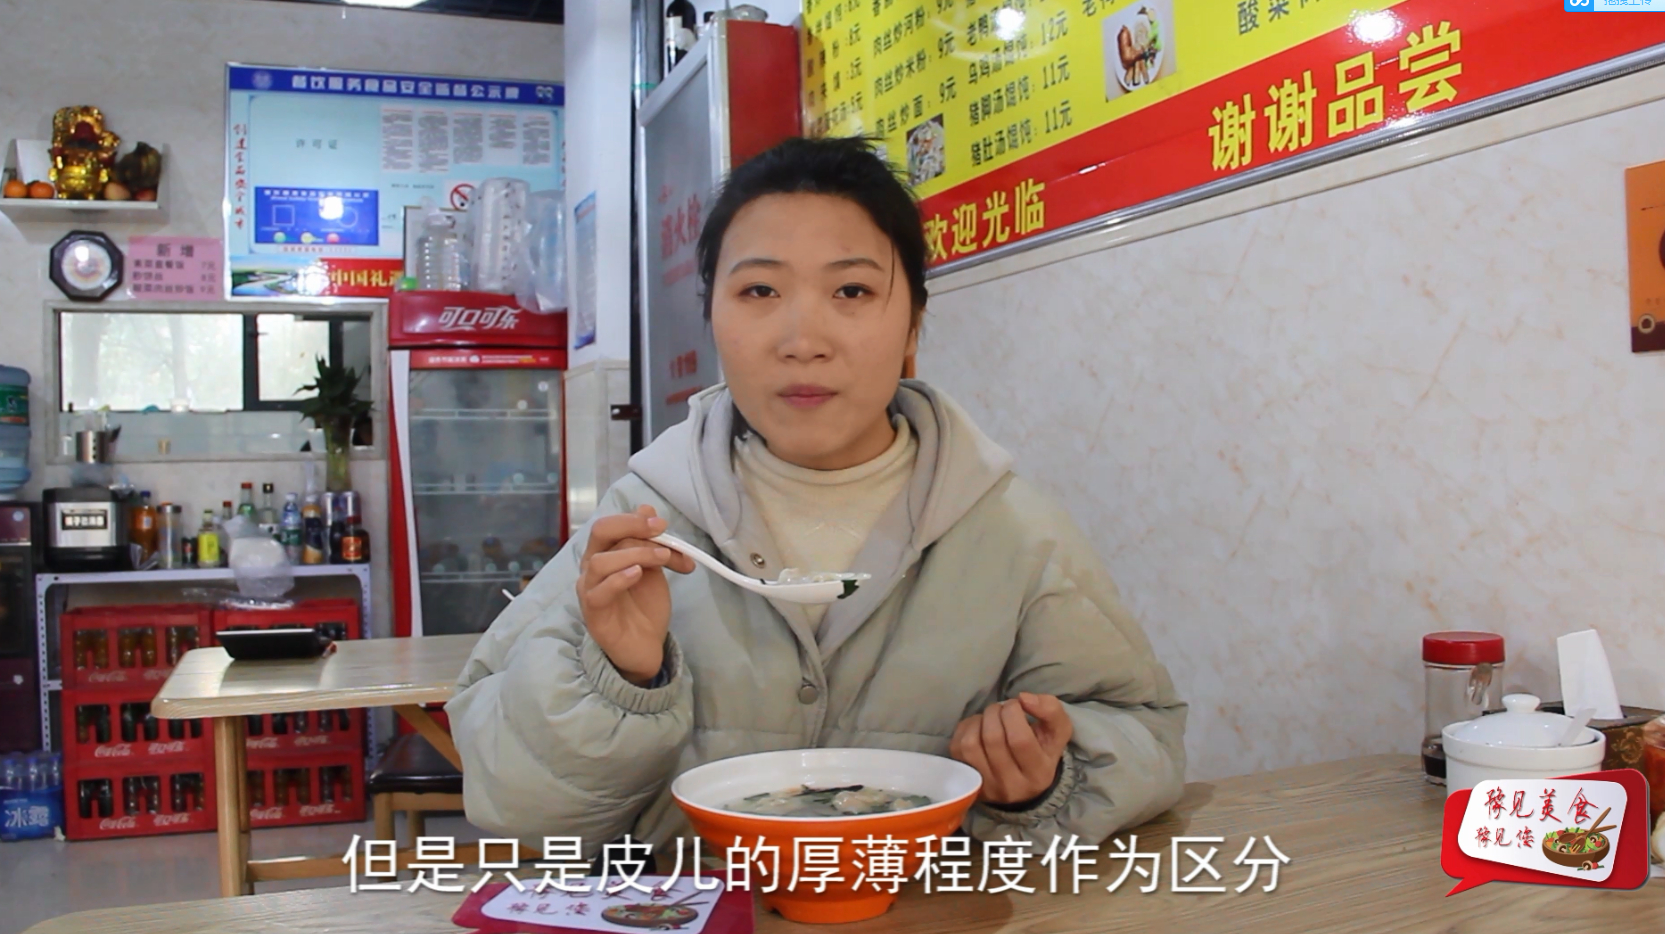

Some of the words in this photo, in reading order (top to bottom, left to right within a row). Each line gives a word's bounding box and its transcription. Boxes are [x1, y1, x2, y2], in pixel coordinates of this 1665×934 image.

[1041, 10, 1068, 46] 12元
[1043, 55, 1070, 90] 11元
[1208, 21, 1462, 171] 谢谢品尝
[1045, 99, 1072, 134] 11元
[924, 178, 1046, 263] 欢迎光临
[438, 305, 523, 332] 可口可乐
[4, 805, 49, 828] 冰露
